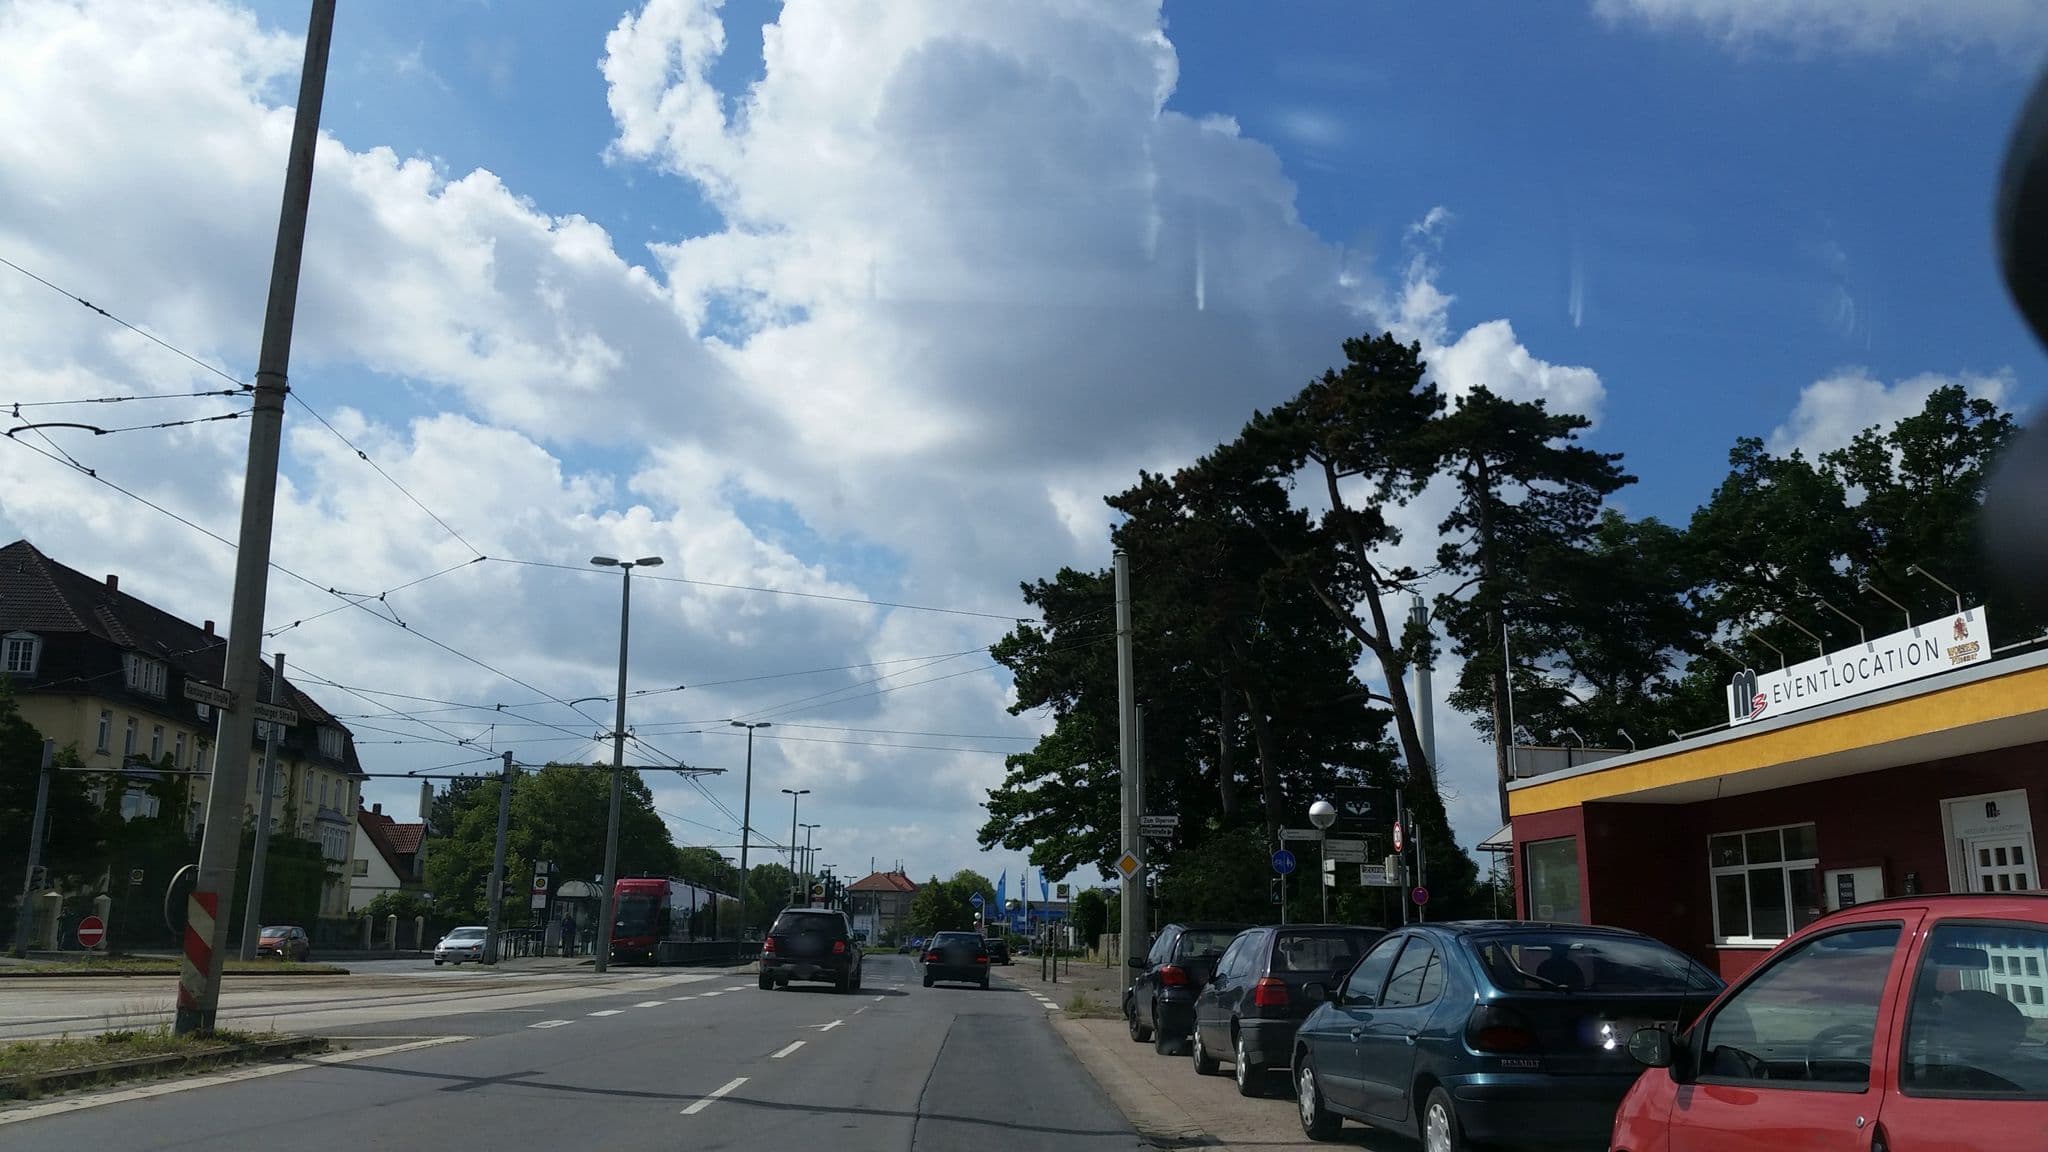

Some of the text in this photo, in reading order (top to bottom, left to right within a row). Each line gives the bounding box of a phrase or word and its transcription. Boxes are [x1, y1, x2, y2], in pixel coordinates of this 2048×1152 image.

[1773, 636, 1940, 704] EVENTLOCATION
[186, 682, 212, 701] Hamburger
[279, 709, 296, 722] Straße
